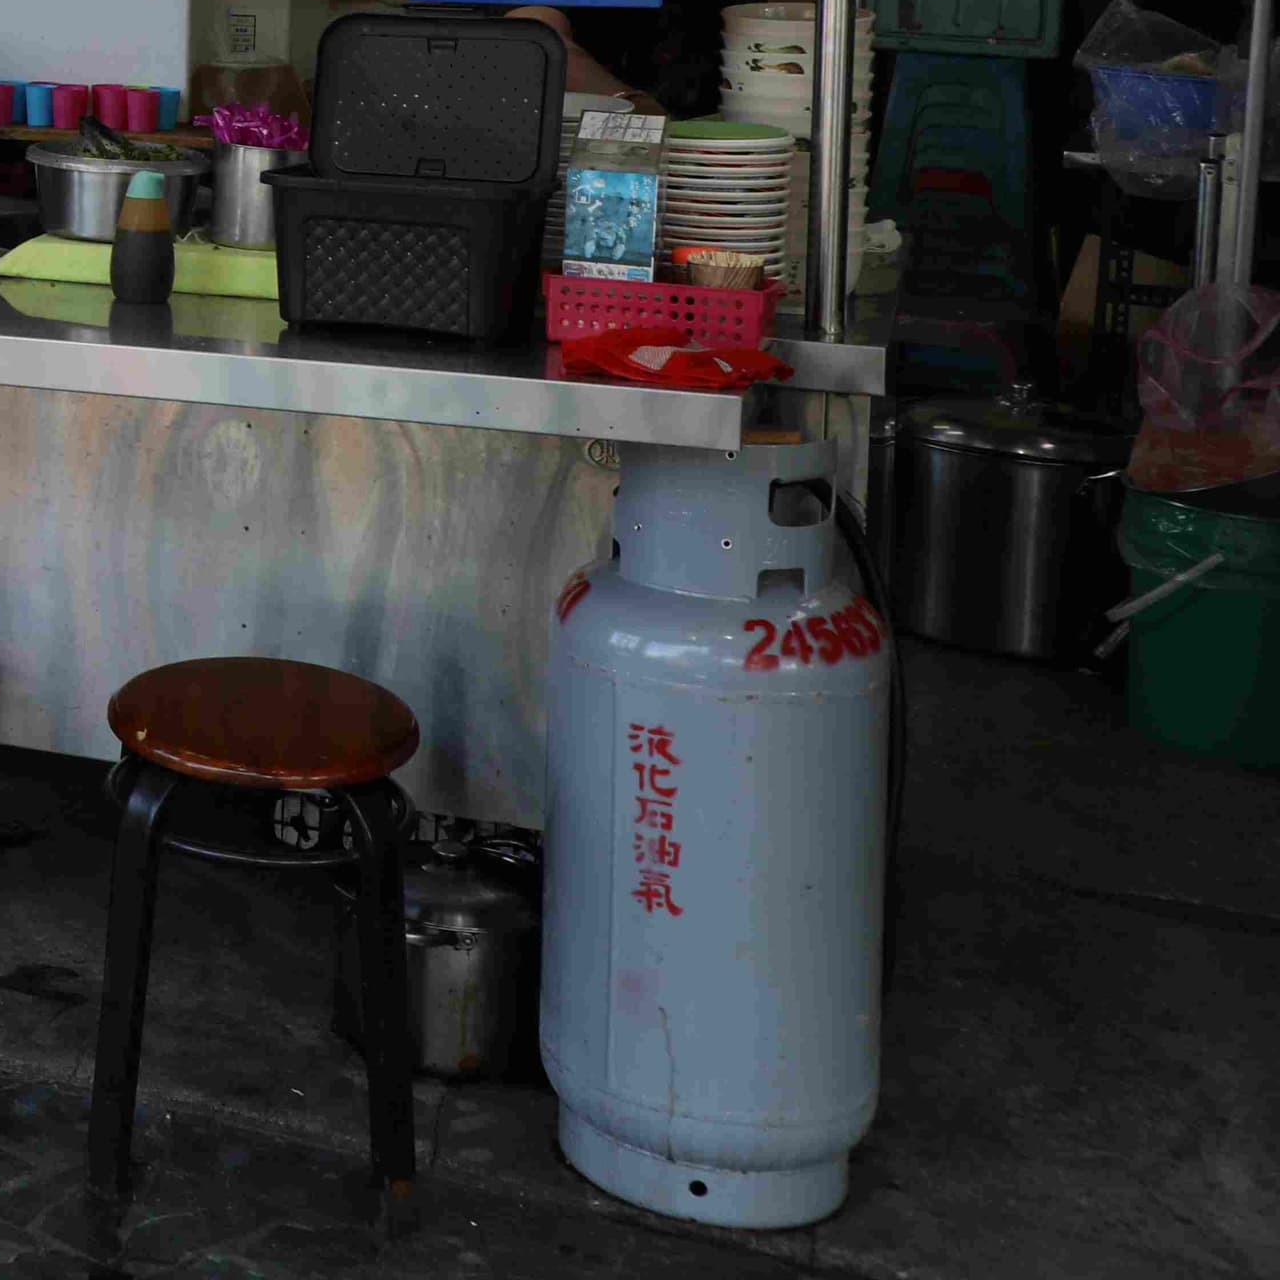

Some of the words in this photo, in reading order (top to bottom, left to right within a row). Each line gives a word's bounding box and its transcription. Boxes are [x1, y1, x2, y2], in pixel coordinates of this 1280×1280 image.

[629, 723, 683, 917] 液化石油氣
